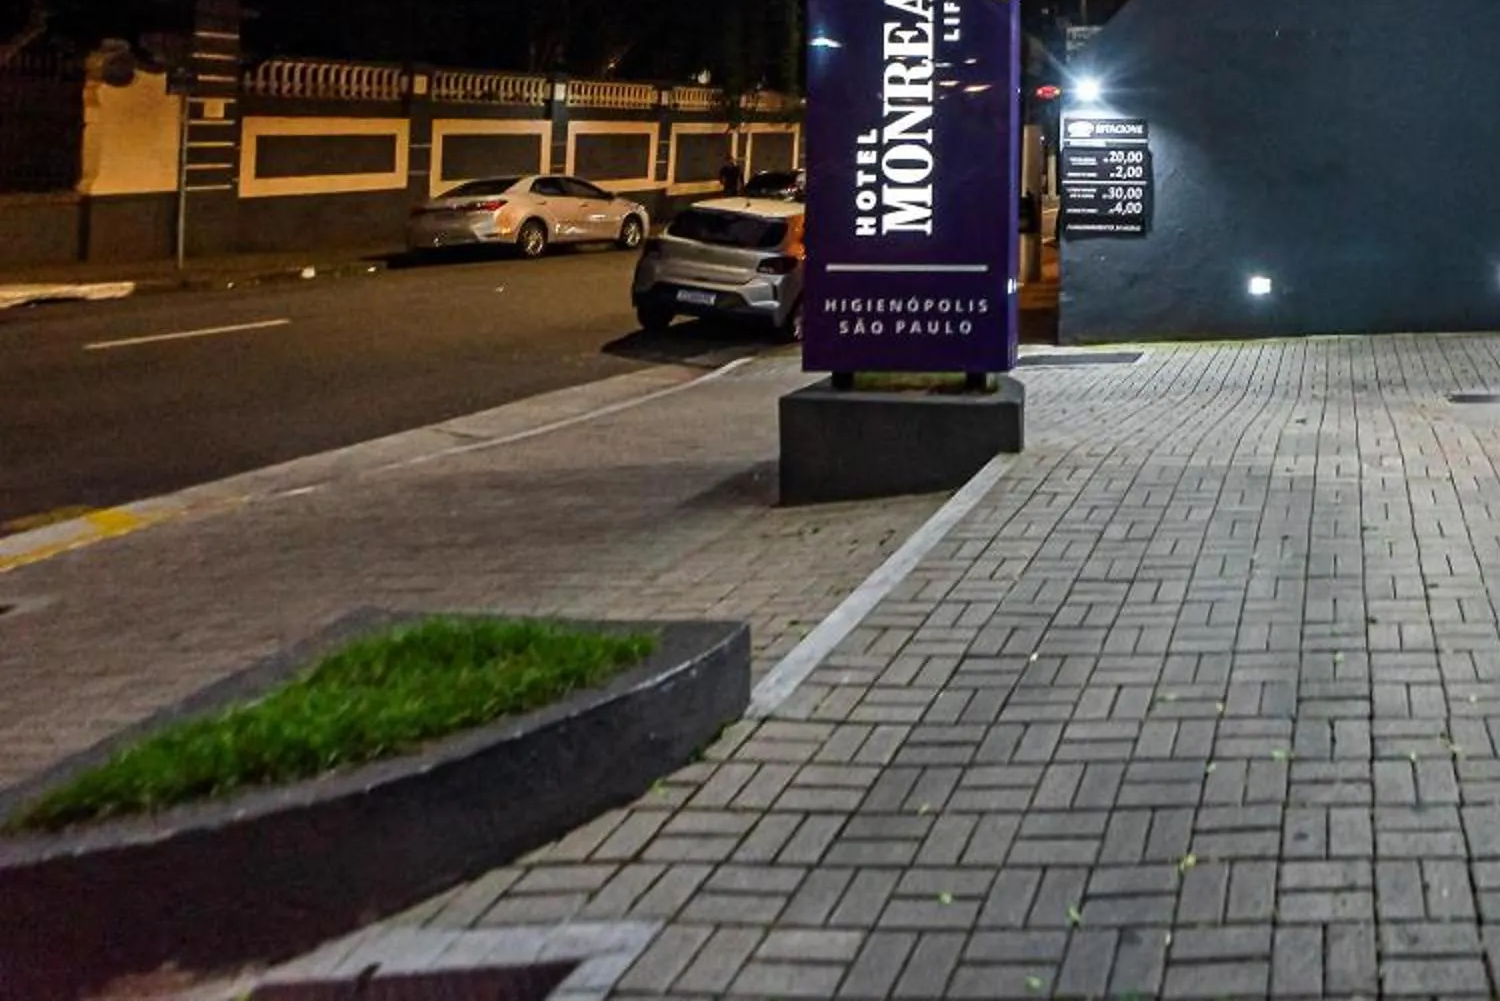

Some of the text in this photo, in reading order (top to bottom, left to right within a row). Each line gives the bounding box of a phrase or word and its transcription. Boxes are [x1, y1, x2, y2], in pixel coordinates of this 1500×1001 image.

[855, 128, 877, 237] HOTEL
[824, 295, 989, 314] HIGIENÓPOLIS
[839, 317, 973, 335] SÃO PAULO
